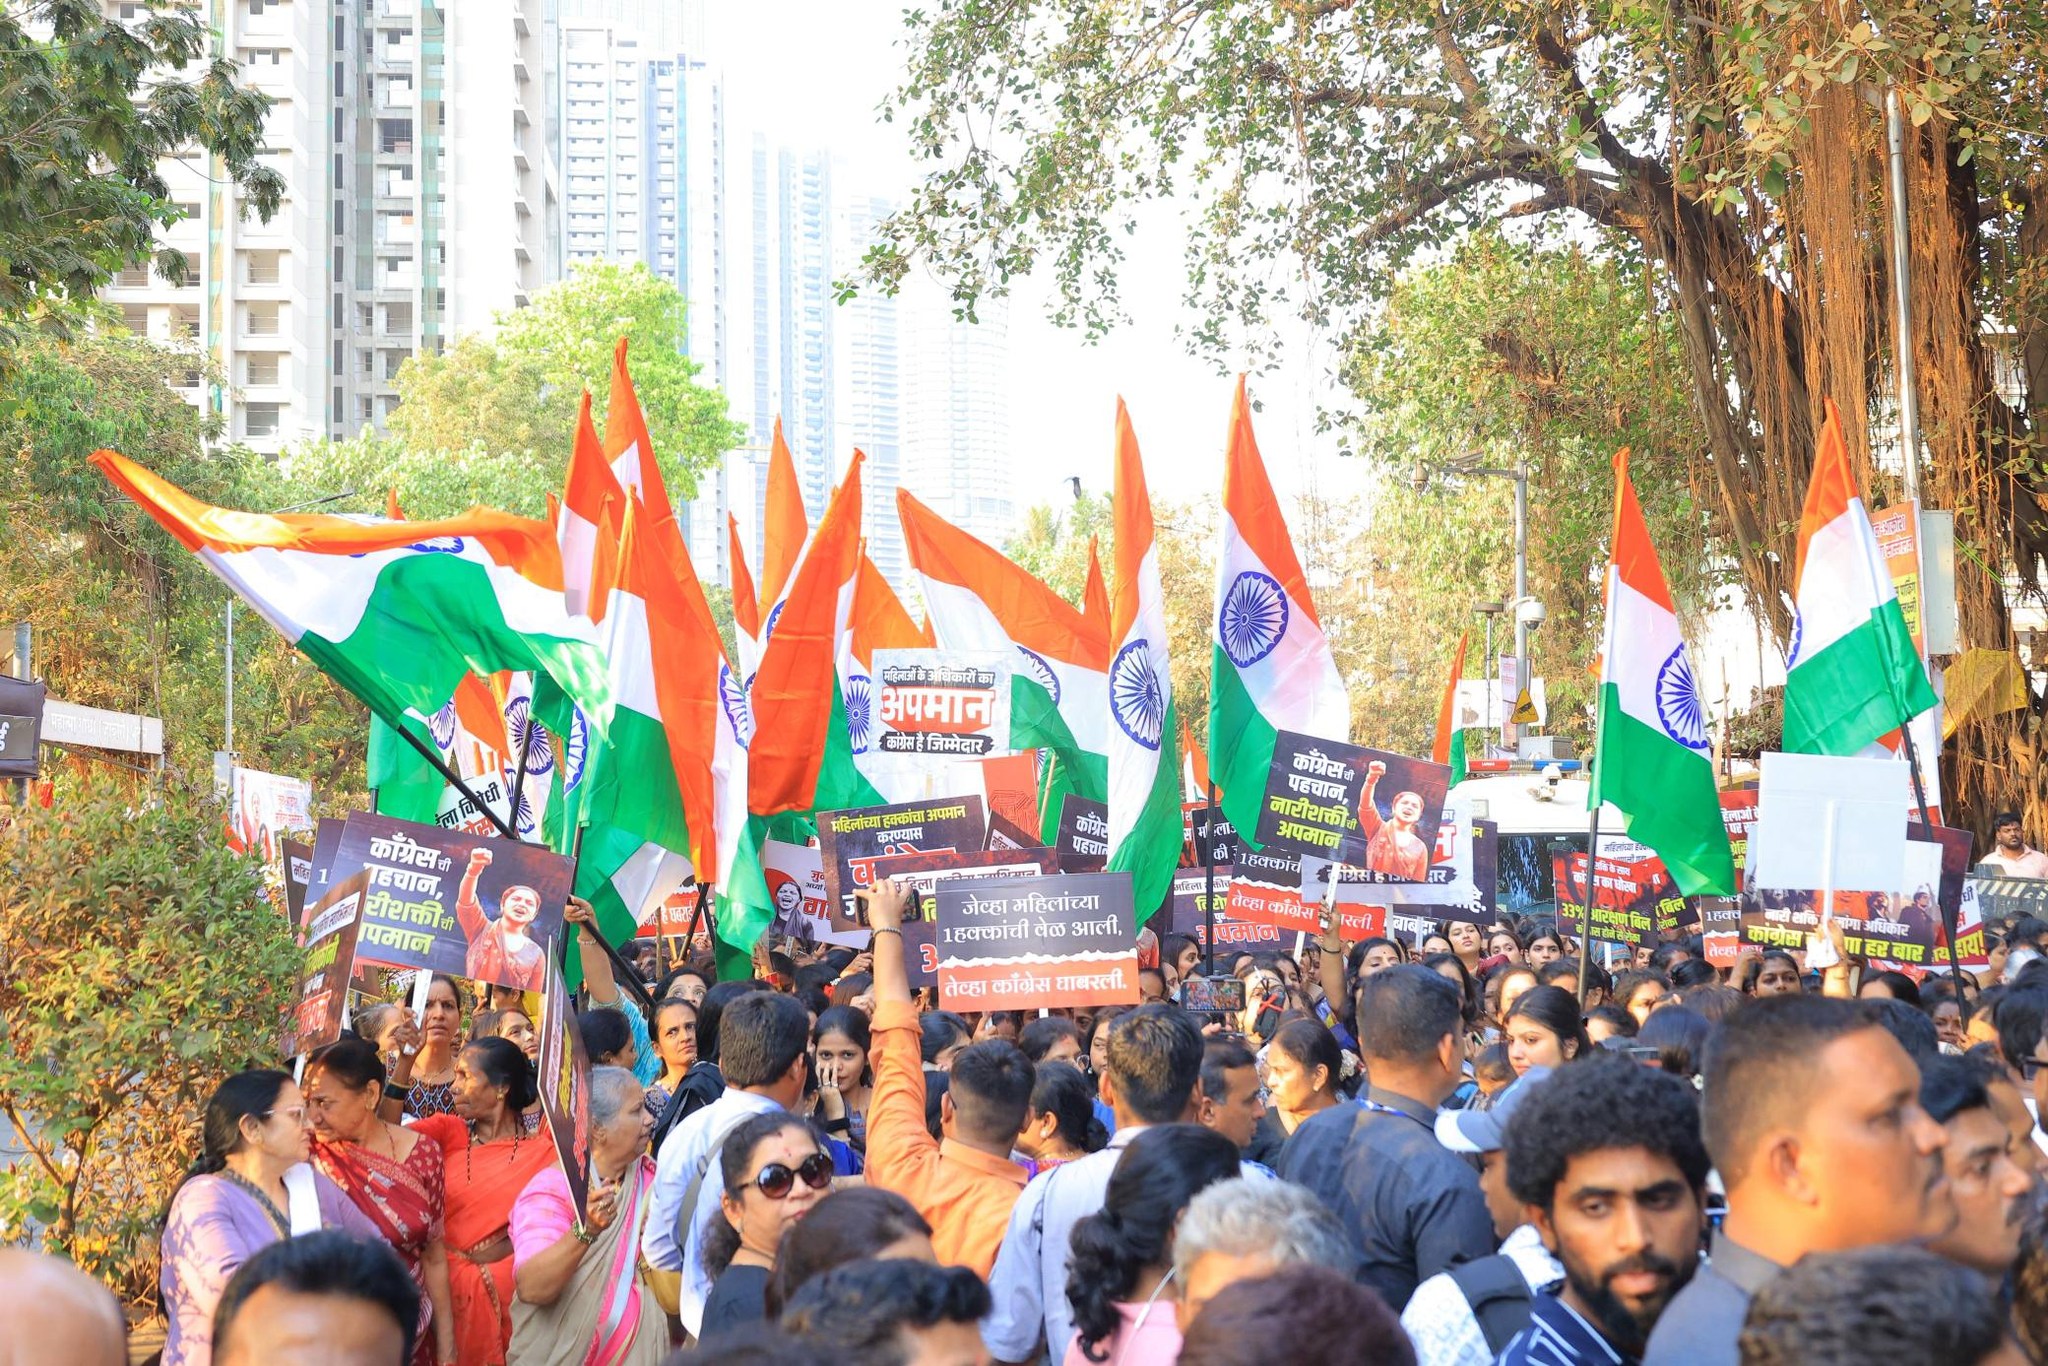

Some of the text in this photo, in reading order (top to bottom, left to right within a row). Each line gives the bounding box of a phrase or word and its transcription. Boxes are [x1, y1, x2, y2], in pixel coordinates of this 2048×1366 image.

[883, 666, 994, 685] महिलाओं के अधिकारों का
[881, 687, 996, 726] अपमान
[886, 731, 984, 753] कांग्रेस है जिम्मेदार
[1293, 748, 1355, 781] काँग्रेस ची
[1288, 773, 1349, 805] पहचान,
[831, 805, 966, 833] महिलांच्या हक्कांचा अपमान
[1270, 795, 1349, 828] नारीशक्ती
[876, 827, 923, 843] करण्यास
[1276, 820, 1343, 850] अपमान
[370, 832, 453, 872] काँग्रेस ची
[1239, 853, 1300, 874] 1हक्कांच
[364, 891, 444, 928] रीशक्ती
[961, 894, 1007, 916] जेव्हा
[1012, 891, 1100, 914] महिलांच्या
[1231, 889, 1264, 913] तेव्हा
[1268, 897, 1315, 920] काँग्रेस
[1034, 916, 1066, 939] वेळ
[1071, 914, 1123, 936] आली,
[1748, 922, 1803, 948] कांग्रेस
[1865, 938, 1888, 957] हर
[1891, 941, 1925, 962] बार
[1955, 929, 1987, 959] हाय!
[945, 967, 1127, 997] तेव्हा काँग्रेस घाबरली.
